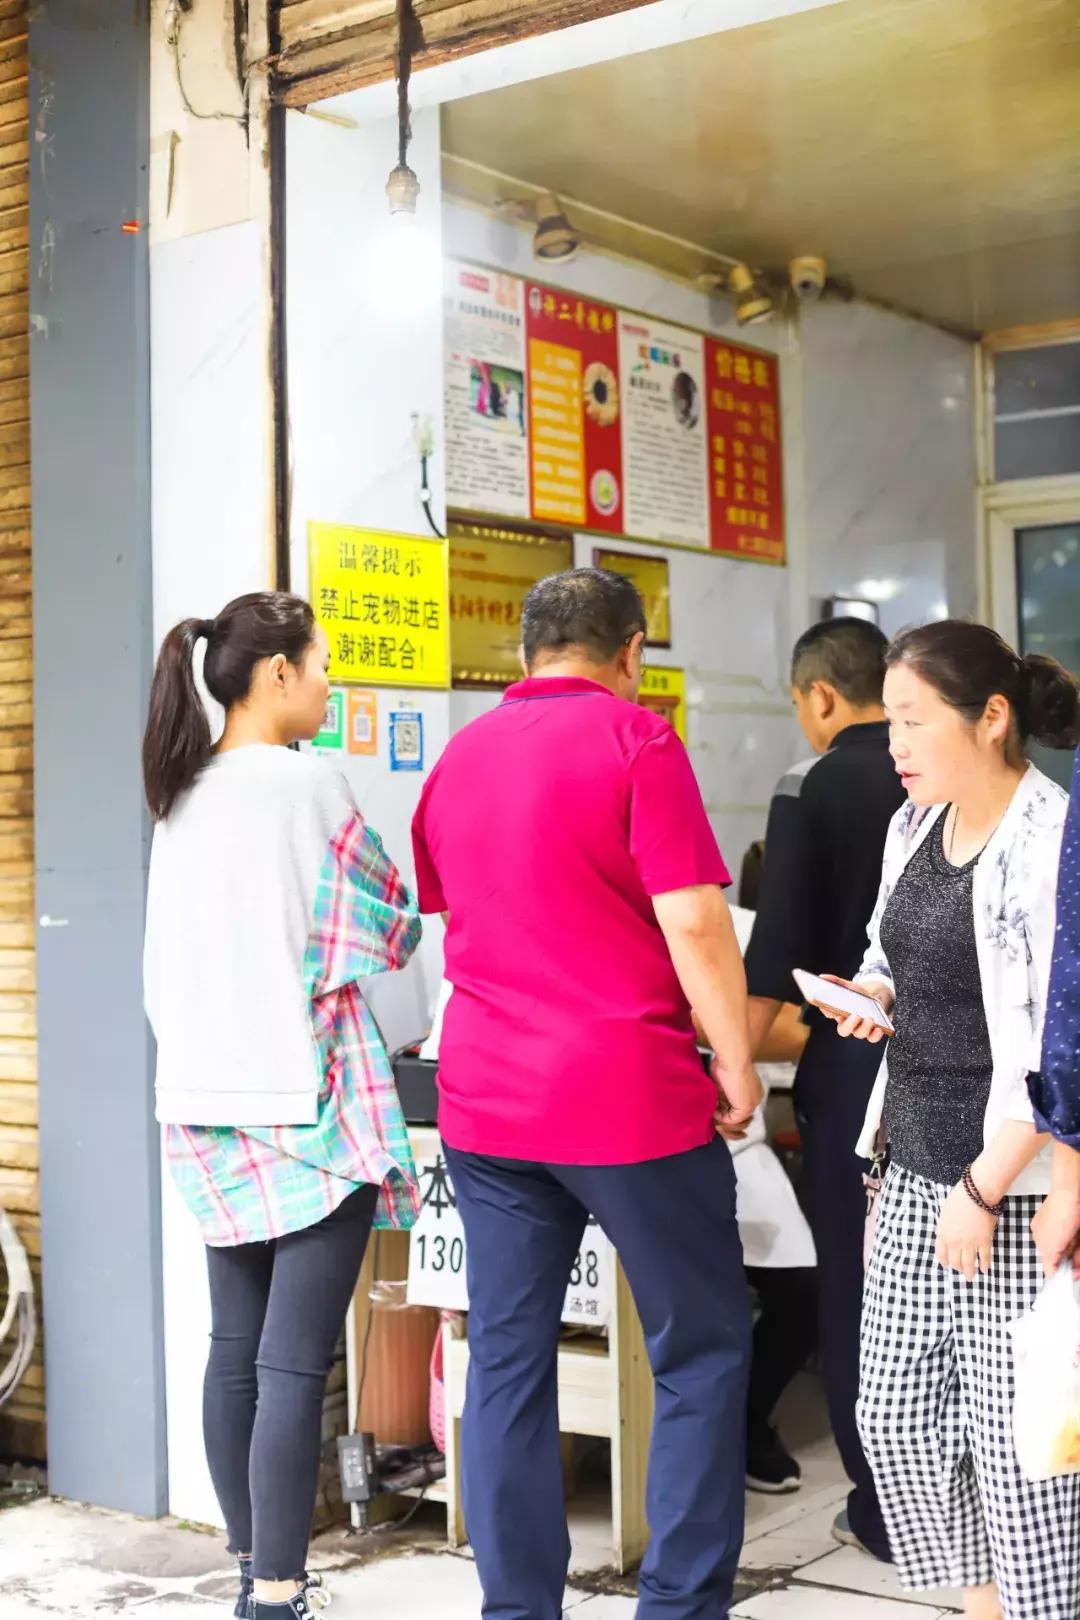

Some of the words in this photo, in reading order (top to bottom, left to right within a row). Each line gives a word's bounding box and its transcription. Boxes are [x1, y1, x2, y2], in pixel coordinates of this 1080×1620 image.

[339, 541, 422, 577] 温馨提示
[320, 587, 440, 630] 禁止宠物进店
[417, 1234, 464, 1273] 130
